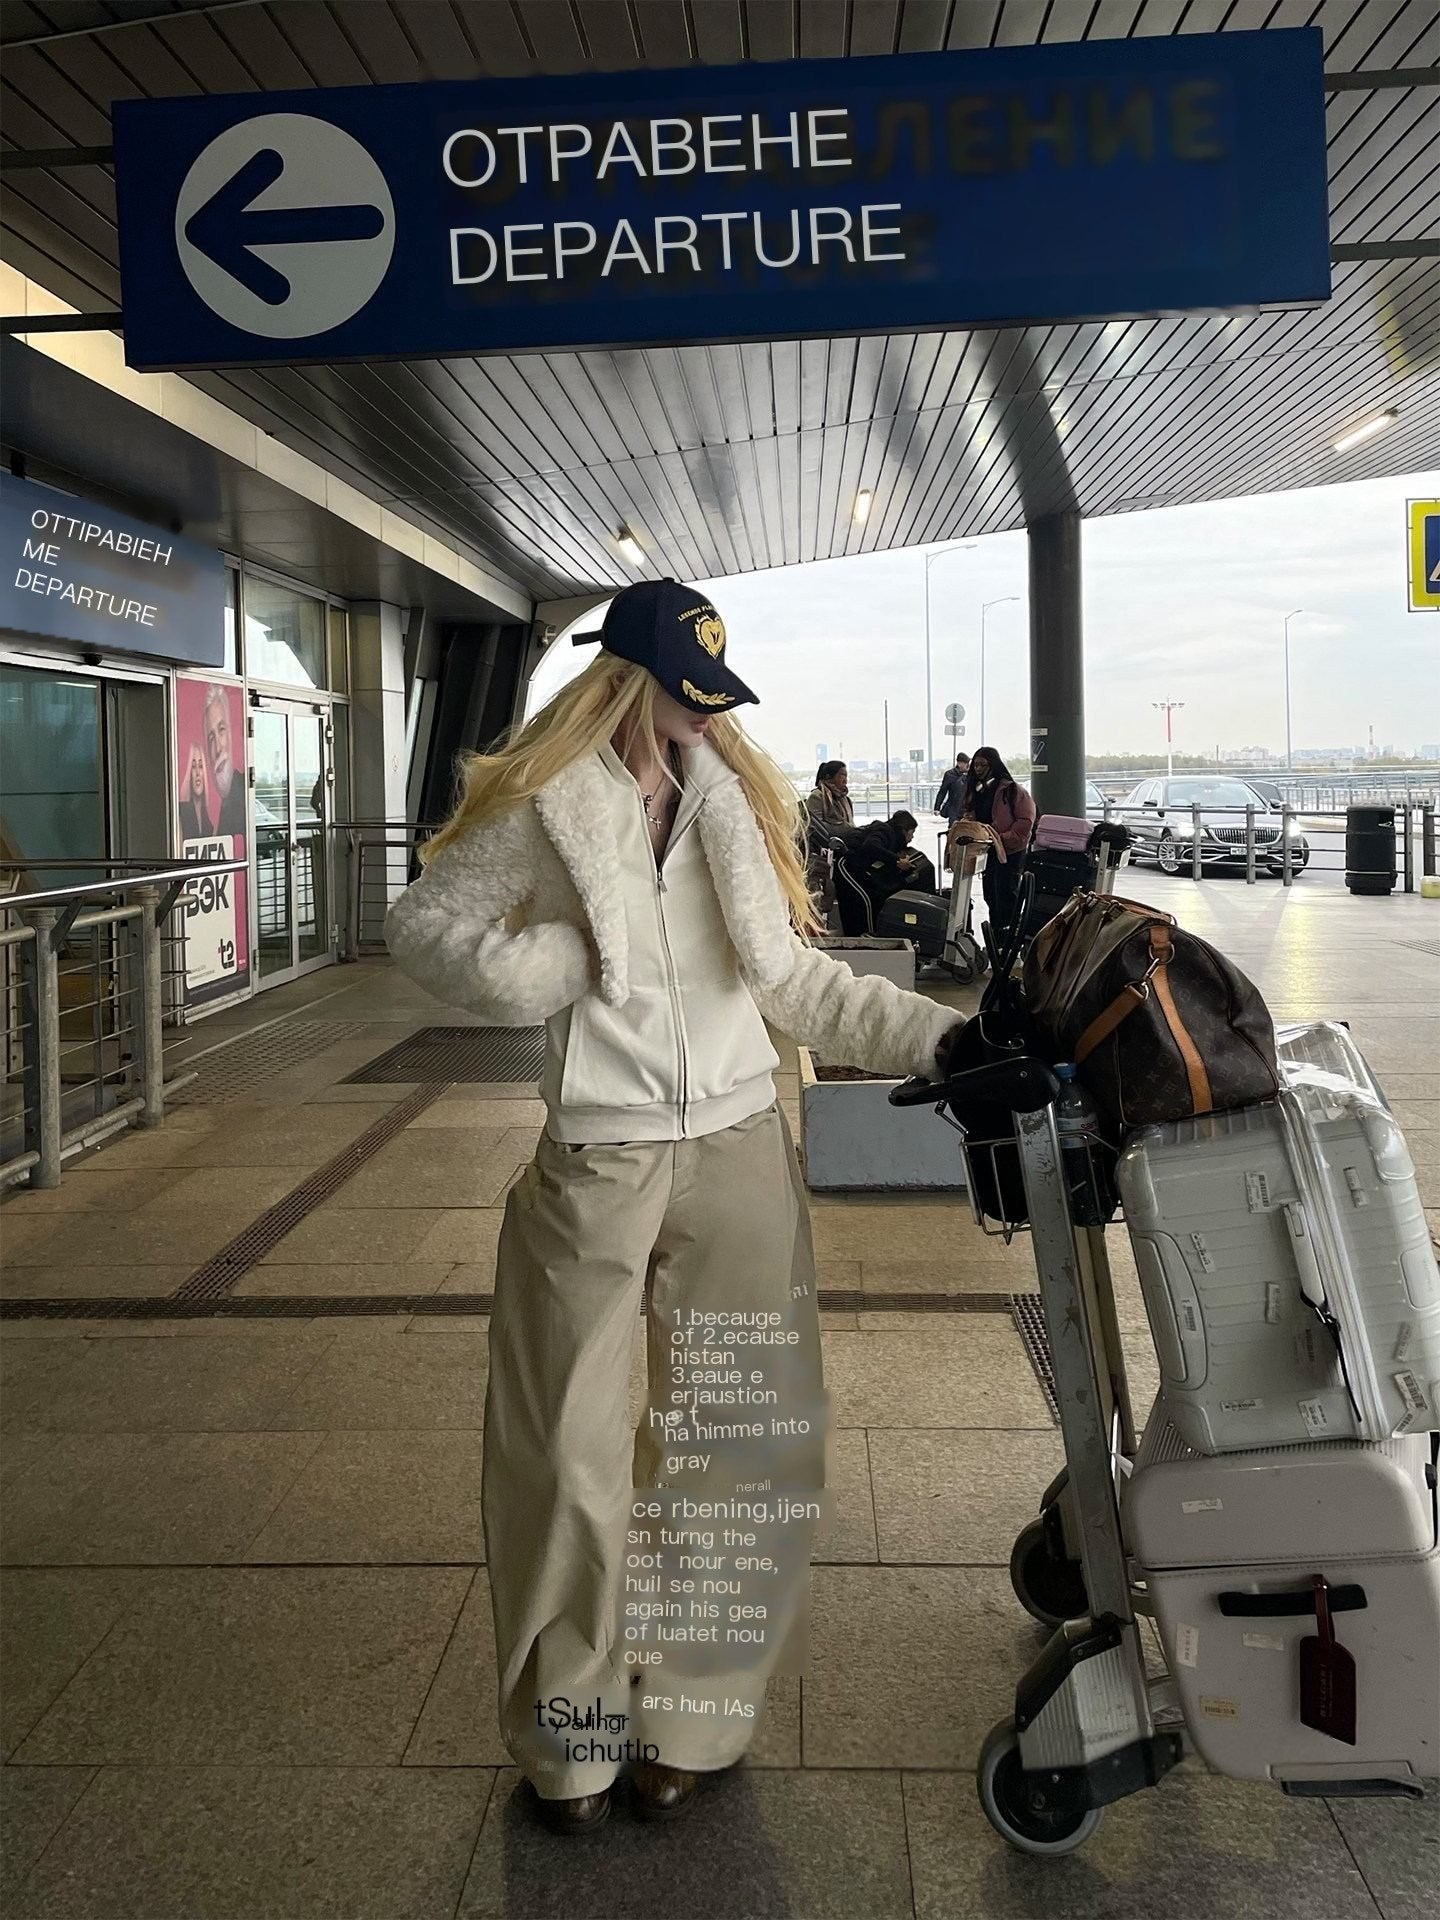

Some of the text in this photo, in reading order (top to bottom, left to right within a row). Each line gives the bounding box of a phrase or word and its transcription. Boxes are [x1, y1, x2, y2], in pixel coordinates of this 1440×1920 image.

[448, 203, 906, 287] DEPARTURE
[14, 568, 158, 627] DEPARTURE
[186, 874, 229, 918] БЭК
[673, 1308, 781, 1329] 1.becauge
[671, 1328, 800, 1345] of 2.ecause
[671, 1348, 735, 1365] histan
[672, 1367, 763, 1384] 3.eaue e
[671, 1387, 777, 1409] erjaustion
[665, 1418, 810, 1442] ha himme into
[666, 1455, 711, 1475] gray
[632, 1501, 662, 1519] ce
[627, 1527, 756, 1549] sn turng the
[626, 1551, 779, 1575] oot nour ene,
[625, 1574, 741, 1594] huil se nou
[625, 1600, 767, 1623] again his gea
[624, 1623, 765, 1643] of luatet nou
[624, 1649, 663, 1665] oue
[642, 1694, 673, 1711] ars
[680, 1694, 716, 1714] hun
